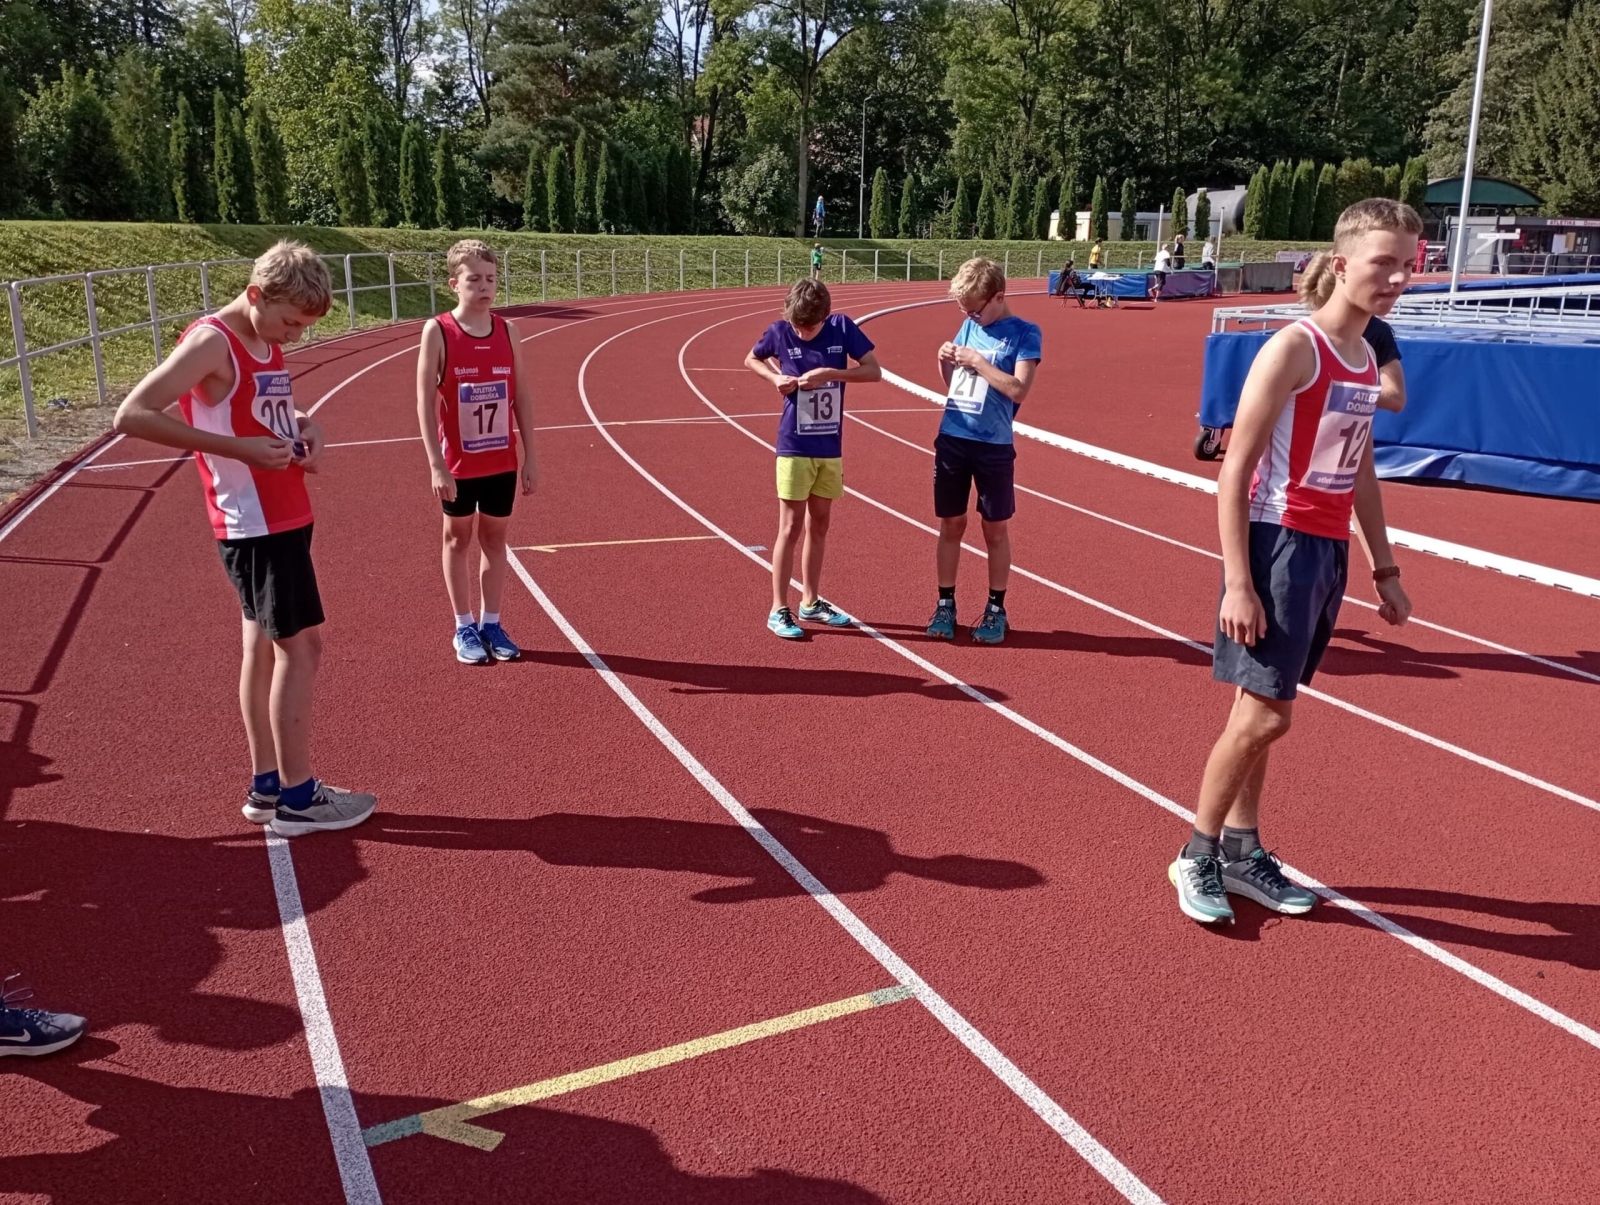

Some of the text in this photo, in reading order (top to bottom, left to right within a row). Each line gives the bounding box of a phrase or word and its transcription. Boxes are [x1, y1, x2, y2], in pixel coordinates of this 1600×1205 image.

[270, 376, 290, 385] ATLETIKA
[472, 386, 497, 395] ATLETIKA
[953, 367, 978, 398] 21
[470, 393, 500, 402] DOBRUŠKA
[809, 392, 833, 420] 13
[260, 399, 295, 439] 20
[473, 403, 498, 435] 17
[1338, 421, 1370, 469] 12
